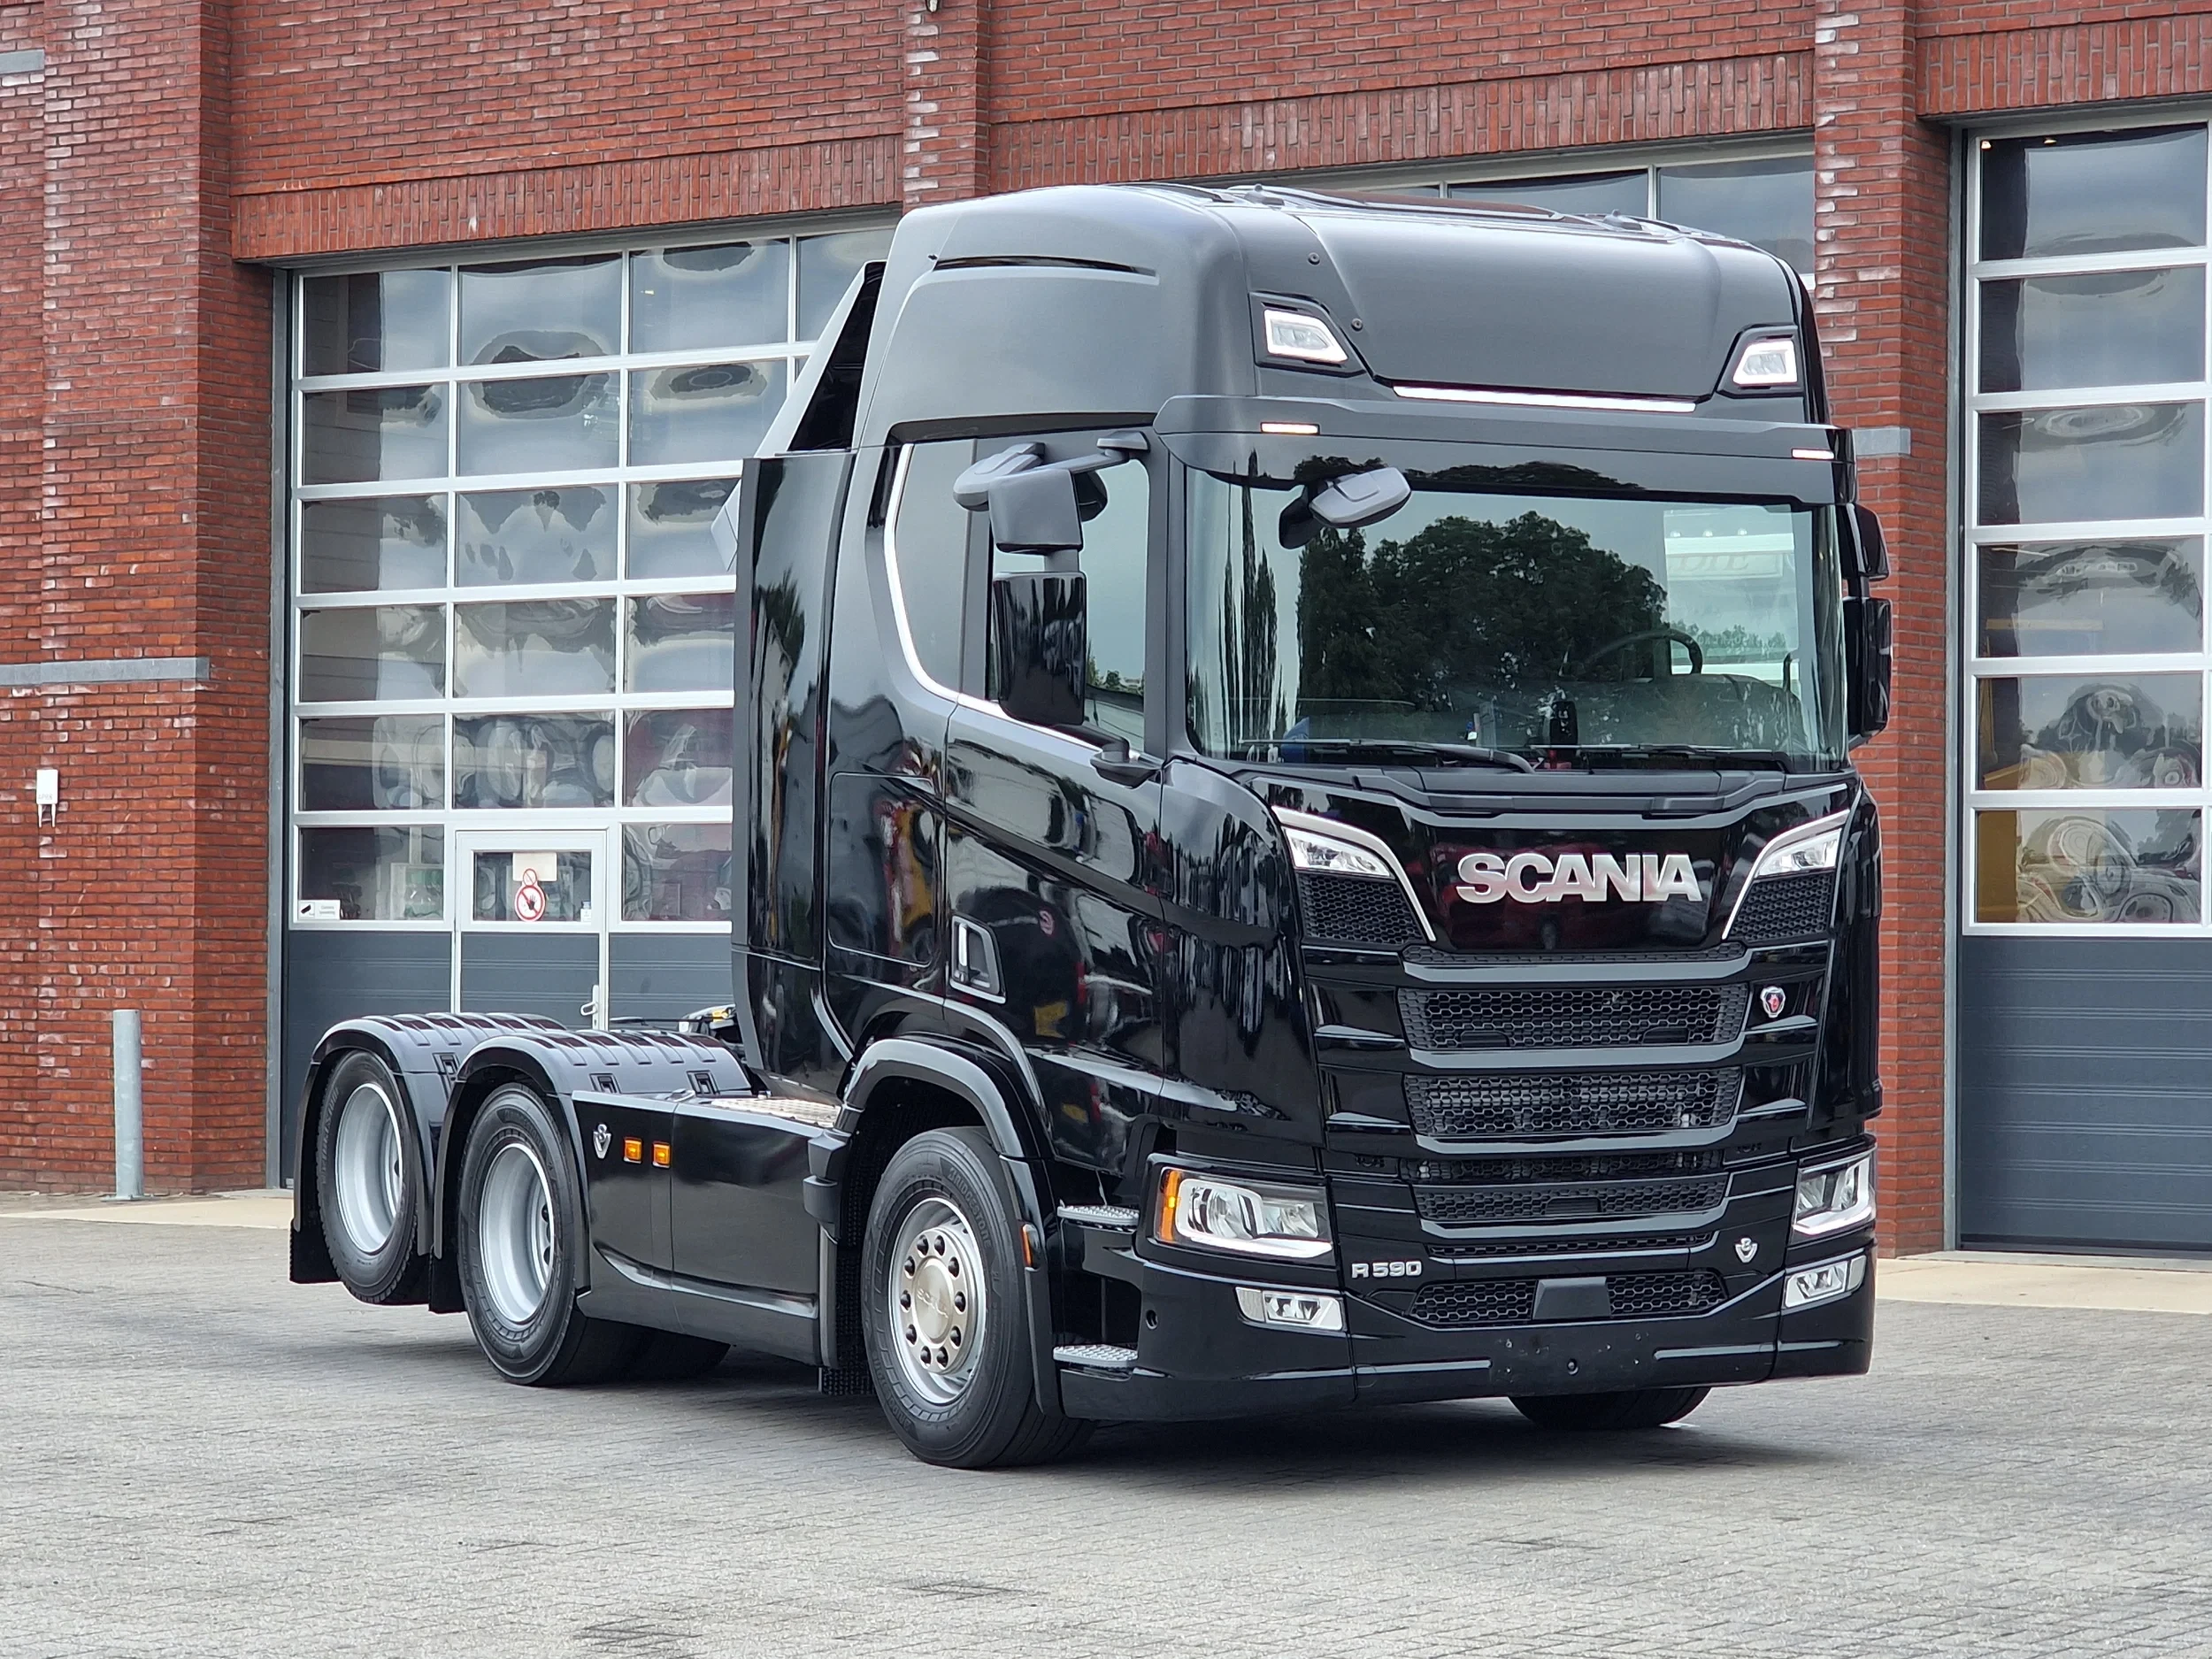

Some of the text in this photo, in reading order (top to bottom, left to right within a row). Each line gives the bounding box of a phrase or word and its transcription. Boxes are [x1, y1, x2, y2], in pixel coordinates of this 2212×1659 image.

[1456, 852, 1702, 903] SCANIA
[1352, 1261, 1422, 1278] R 590
